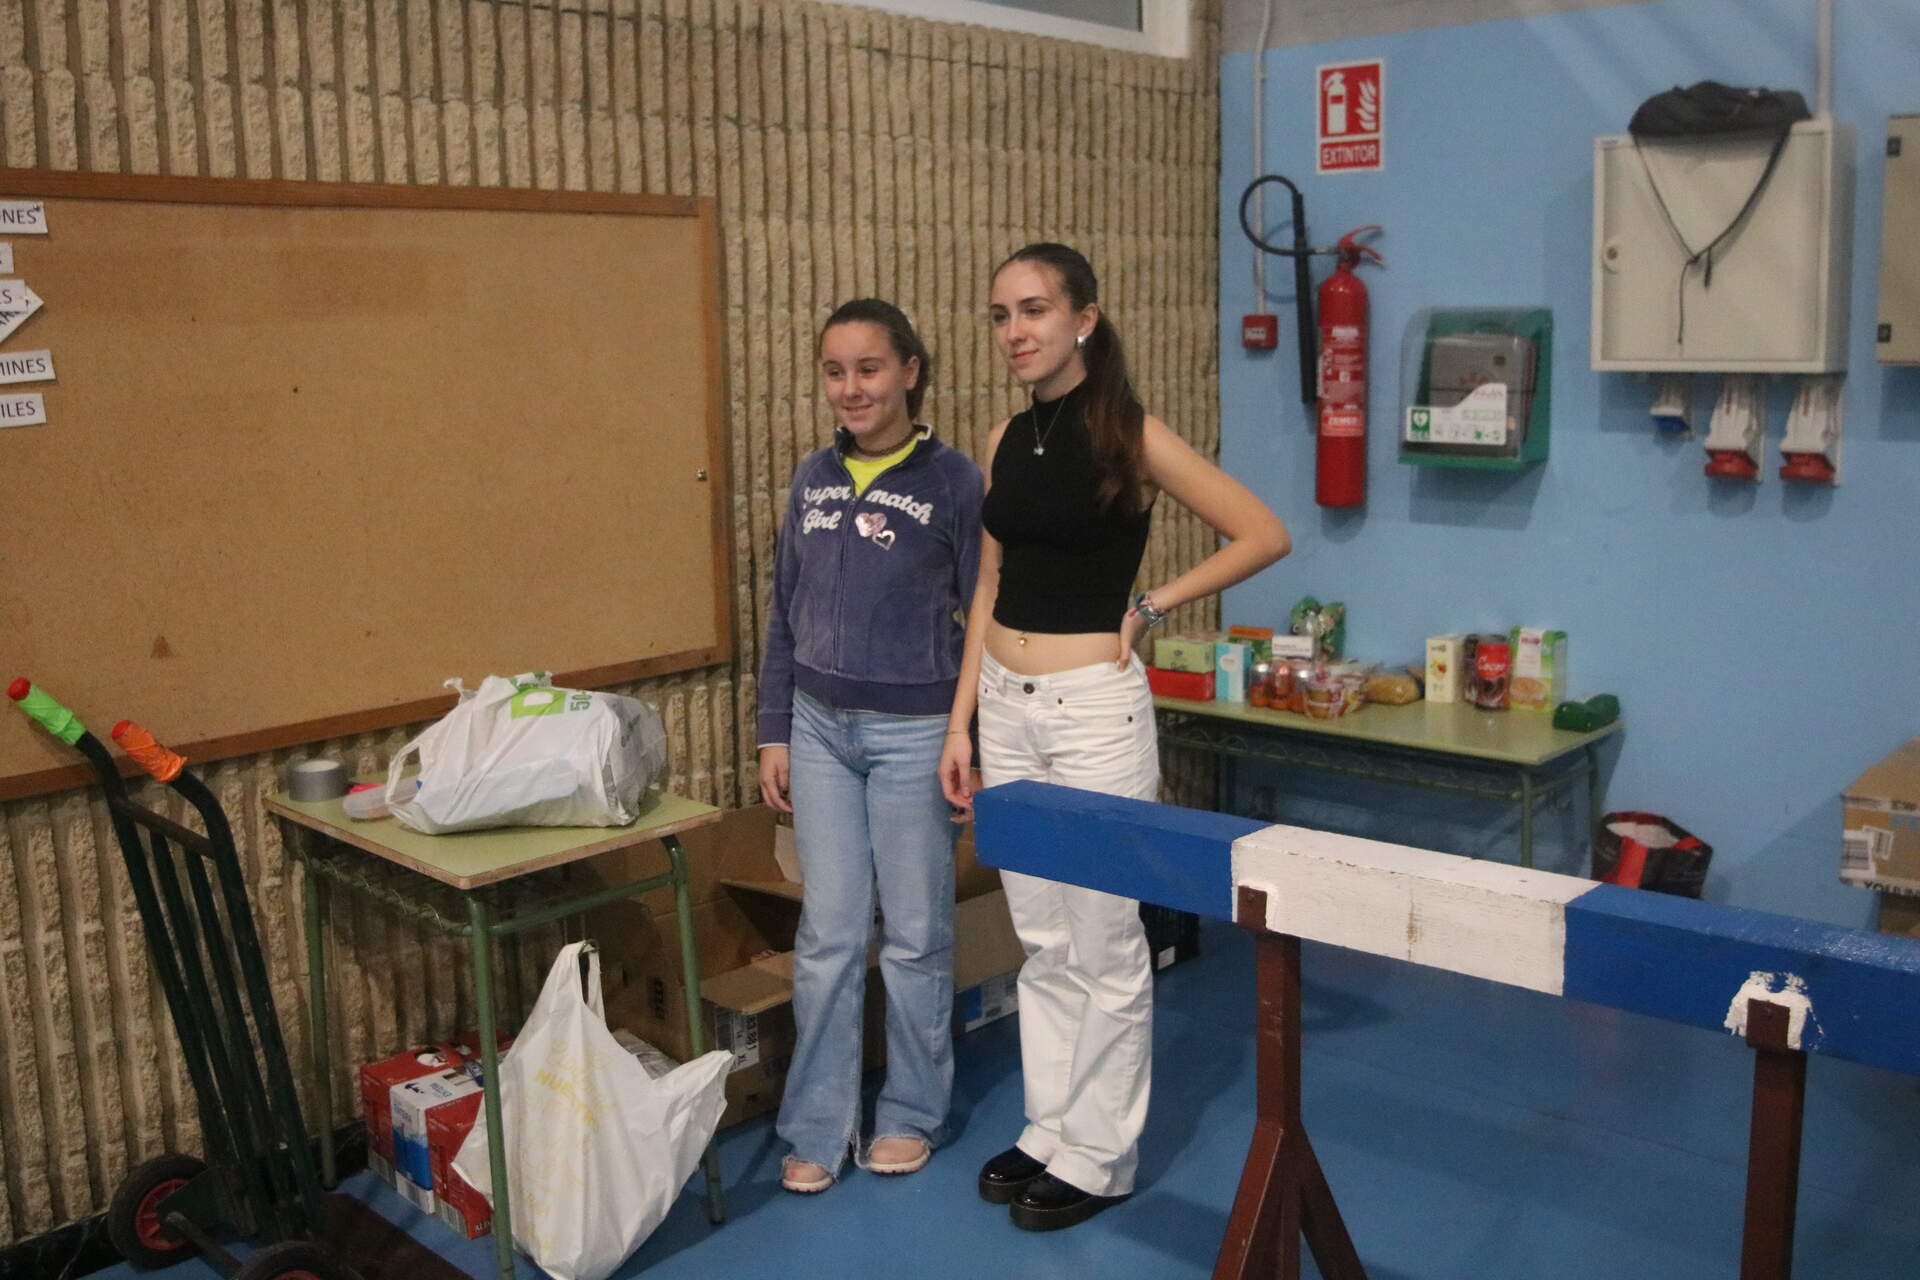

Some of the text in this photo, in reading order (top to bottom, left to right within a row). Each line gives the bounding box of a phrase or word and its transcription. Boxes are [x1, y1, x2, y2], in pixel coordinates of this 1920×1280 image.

[1322, 143, 1377, 165] EXTINTOR
[0, 208, 37, 225] NES
[802, 508, 843, 535] Girl
